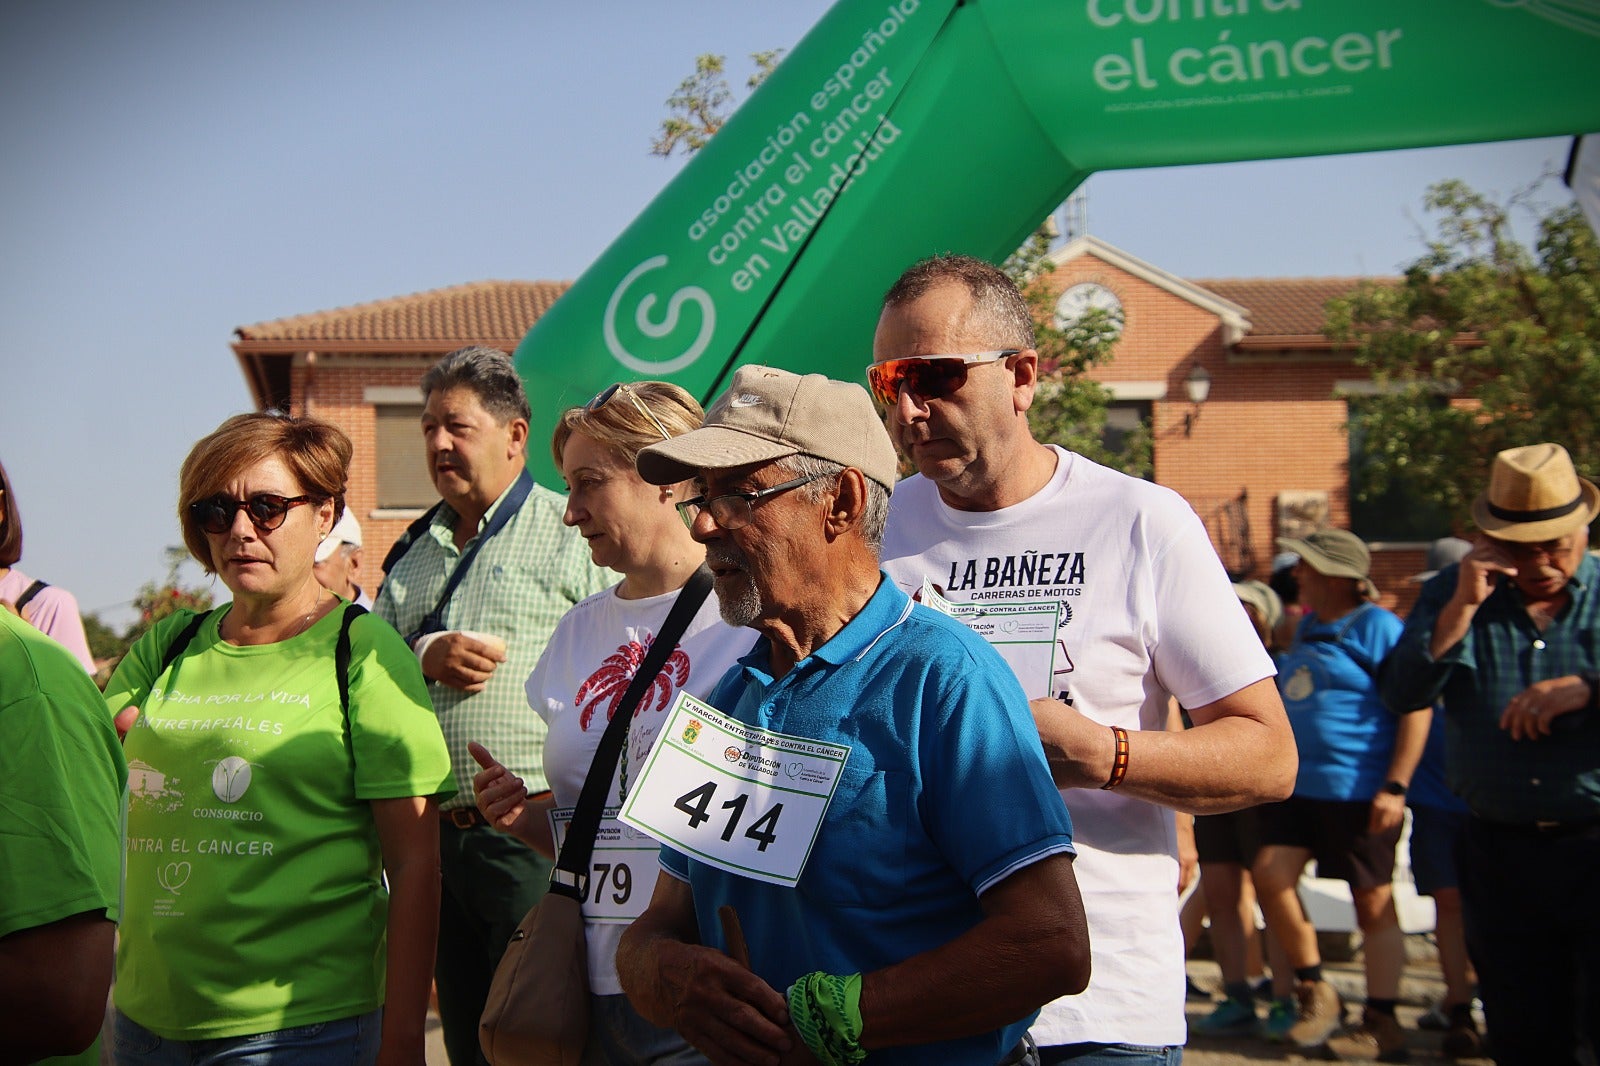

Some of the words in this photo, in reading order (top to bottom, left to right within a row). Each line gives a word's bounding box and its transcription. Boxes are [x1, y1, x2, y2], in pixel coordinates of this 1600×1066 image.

[1093, 38, 1158, 91] el
[1168, 29, 1403, 86] cáncer
[688, 111, 811, 240] asociación
[810, 0, 919, 110] española
[708, 183, 787, 265] contra
[784, 151, 813, 184] el
[810, 67, 892, 158] cáncer
[731, 253, 770, 292] en
[760, 113, 901, 253] Valladolid
[946, 559, 977, 591] LA
[982, 550, 1085, 588] BAÑEZA
[970, 589, 1025, 600] CARRERAS
[1027, 589, 1041, 598] DE
[1043, 588, 1081, 597] MOTOS
[205, 694, 241, 705] POR
[244, 693, 264, 703] LA
[271, 690, 310, 709] VIDA
[136, 714, 283, 736] ENTRETAPIALES
[692, 705, 723, 725] MARCHA
[781, 740, 806, 751] CONTRA
[806, 745, 815, 753] EL
[816, 746, 844, 758] CÁNCER
[193, 808, 263, 821] CONSORCIO
[673, 781, 784, 852] 414
[126, 838, 163, 852] ONTRA
[171, 838, 190, 853] EL
[198, 840, 274, 856] CANCER
